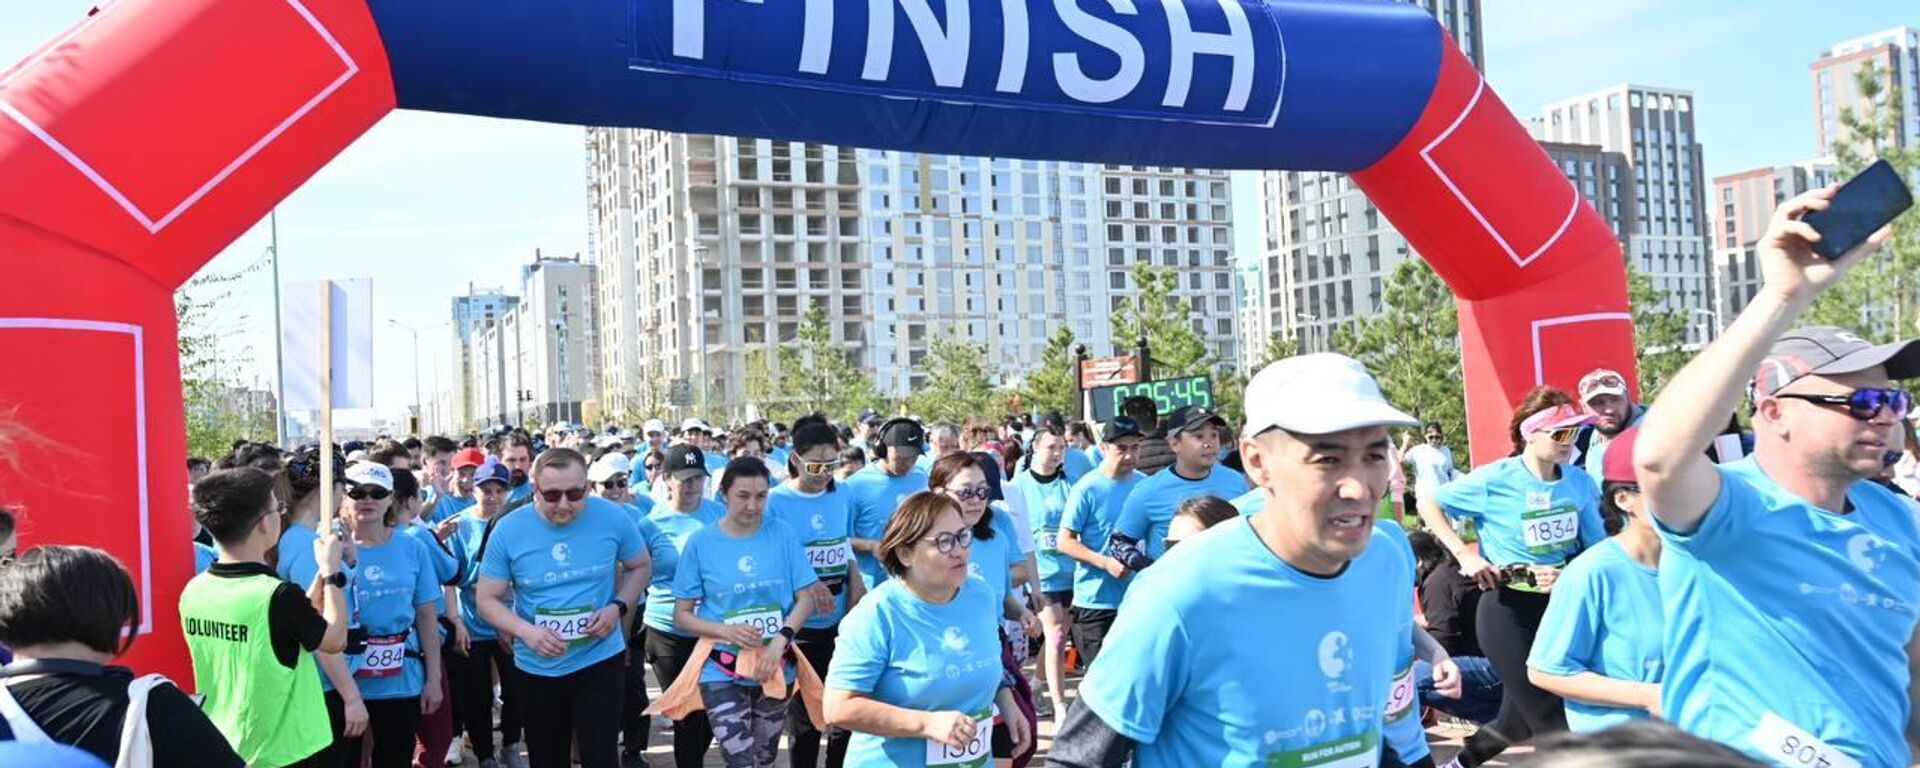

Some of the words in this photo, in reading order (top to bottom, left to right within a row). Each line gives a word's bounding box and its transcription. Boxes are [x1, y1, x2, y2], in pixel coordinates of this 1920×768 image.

[1527, 517, 1575, 542] 1834
[807, 547, 844, 565] 1409
[366, 647, 402, 667] 684
